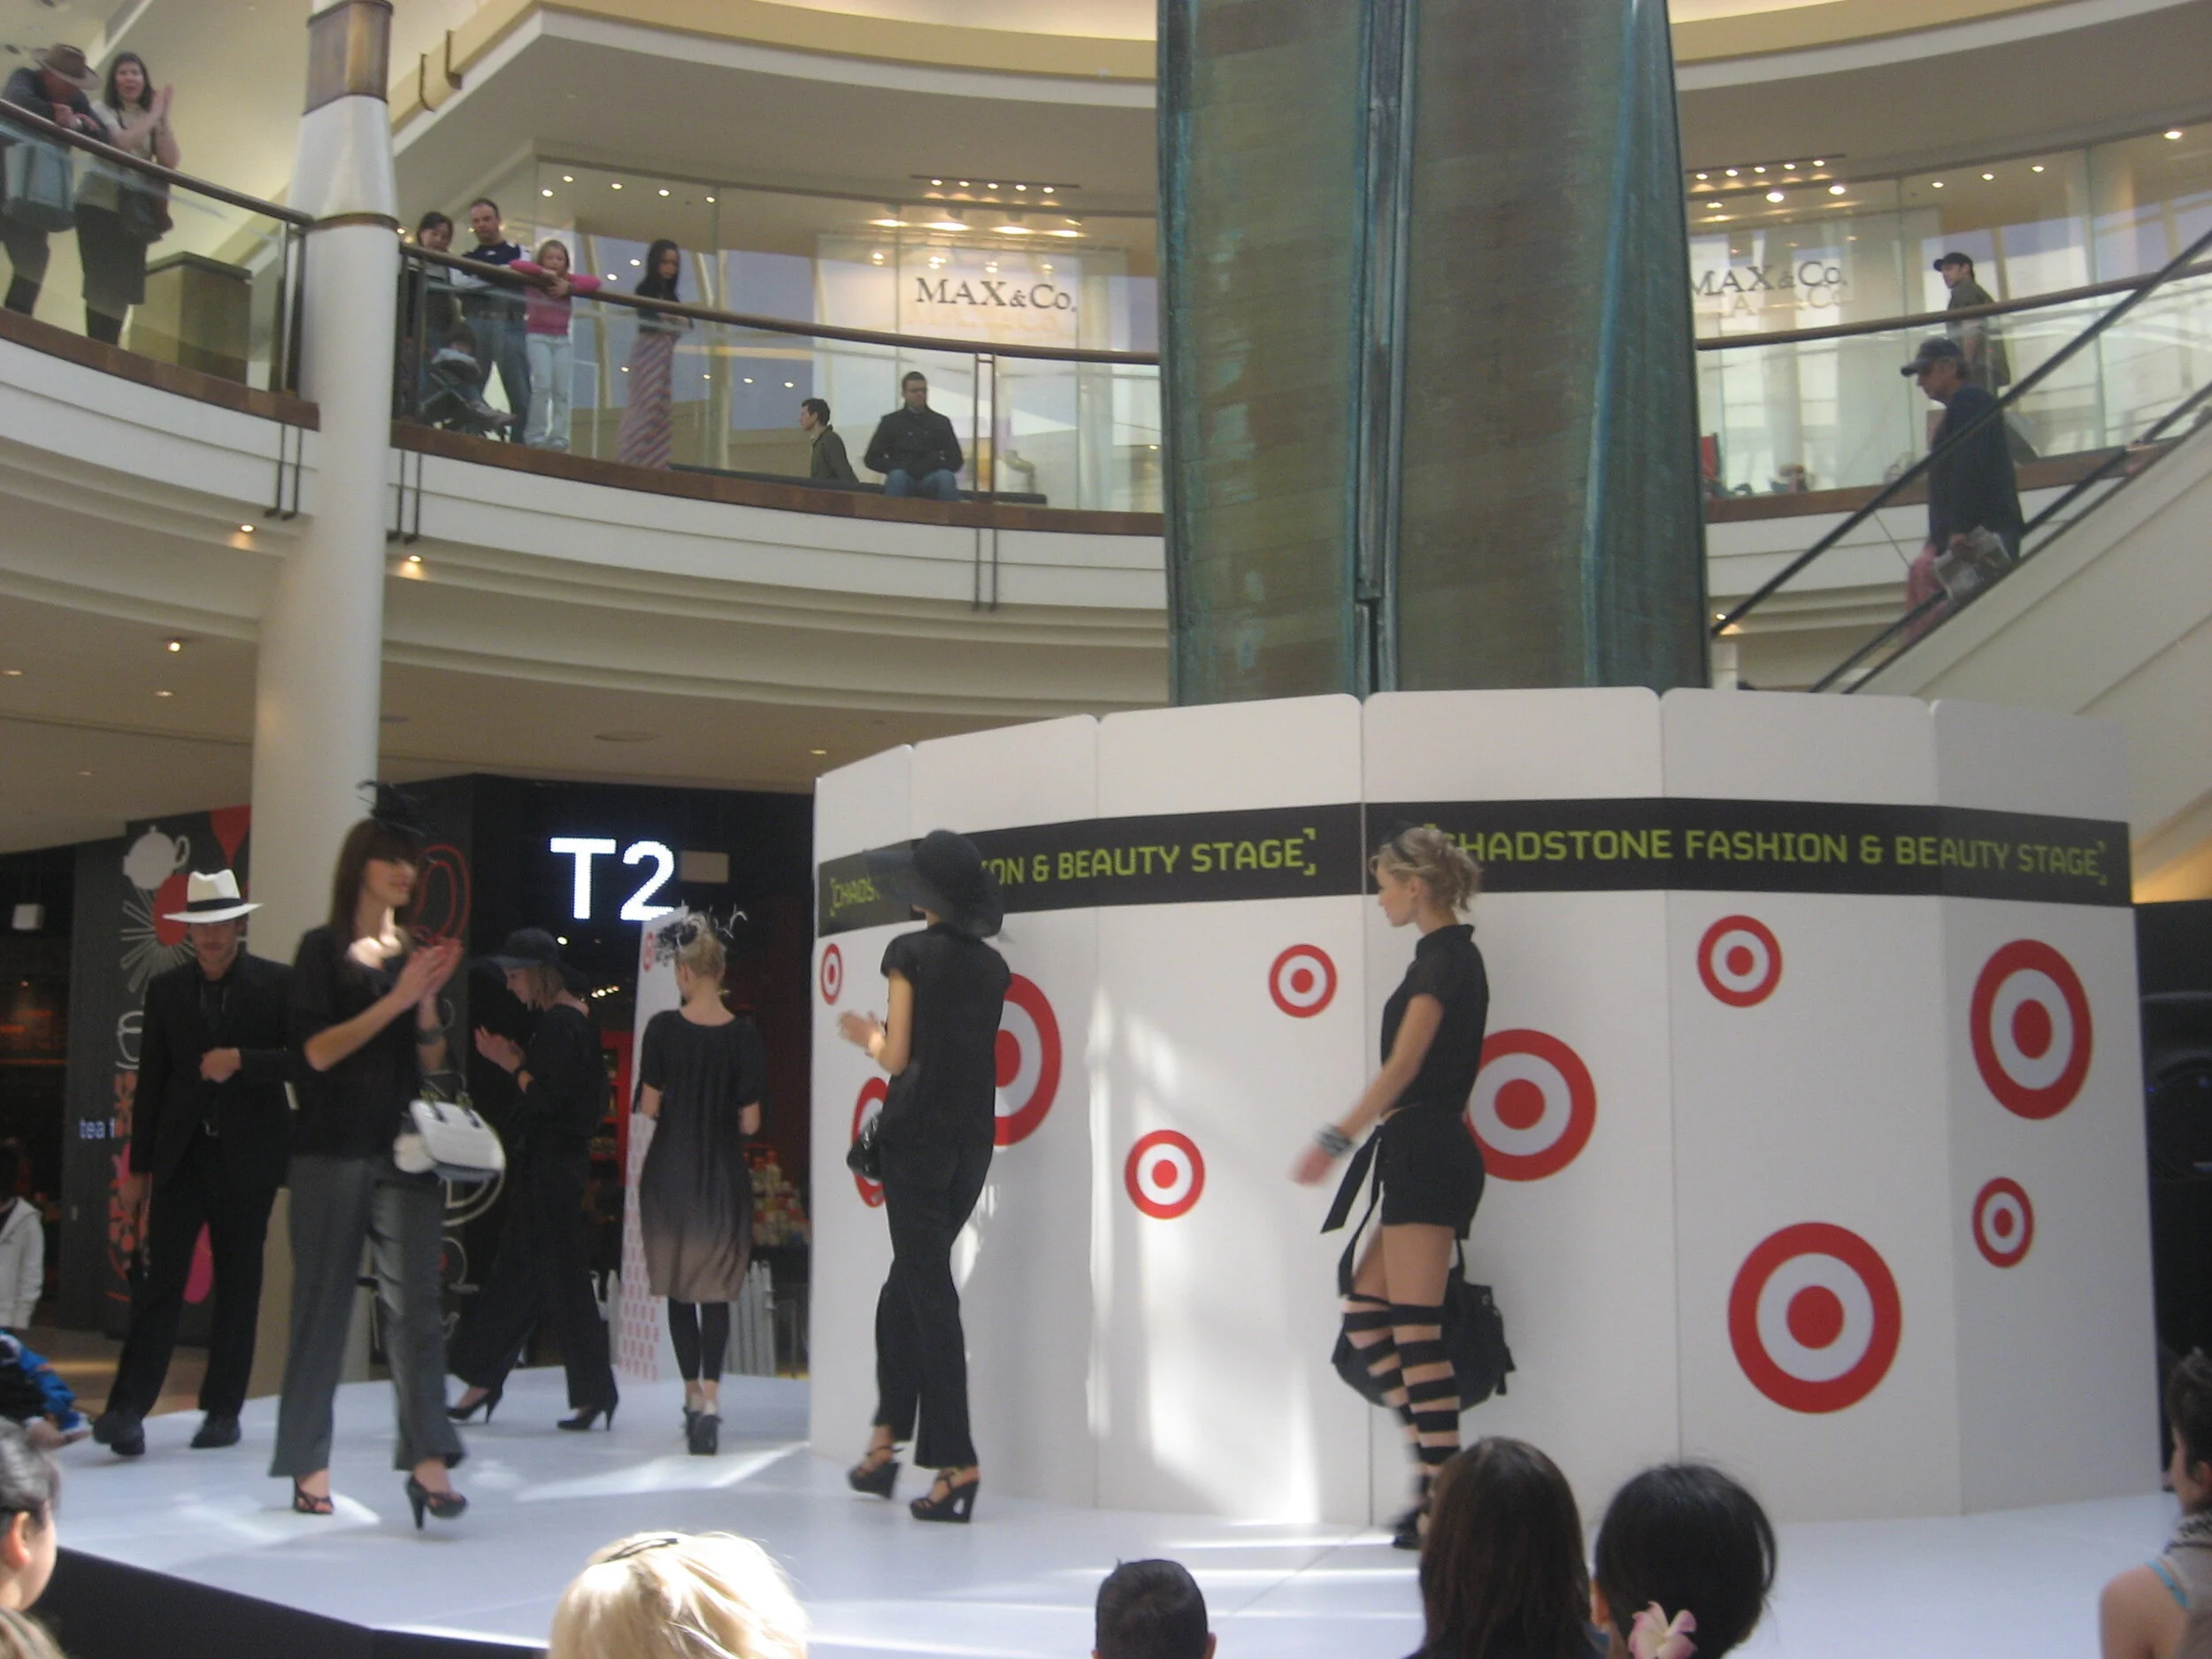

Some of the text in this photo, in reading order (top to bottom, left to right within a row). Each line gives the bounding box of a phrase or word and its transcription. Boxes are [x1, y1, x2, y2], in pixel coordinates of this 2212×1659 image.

[1033, 854, 1051, 883] &
[1057, 845, 1181, 880] BEAUTY
[1191, 838, 1305, 873] STAGE
[1442, 828, 2100, 878] HADSTONE FASHION & BEAUTY STAGE
[549, 837, 675, 921] T2
